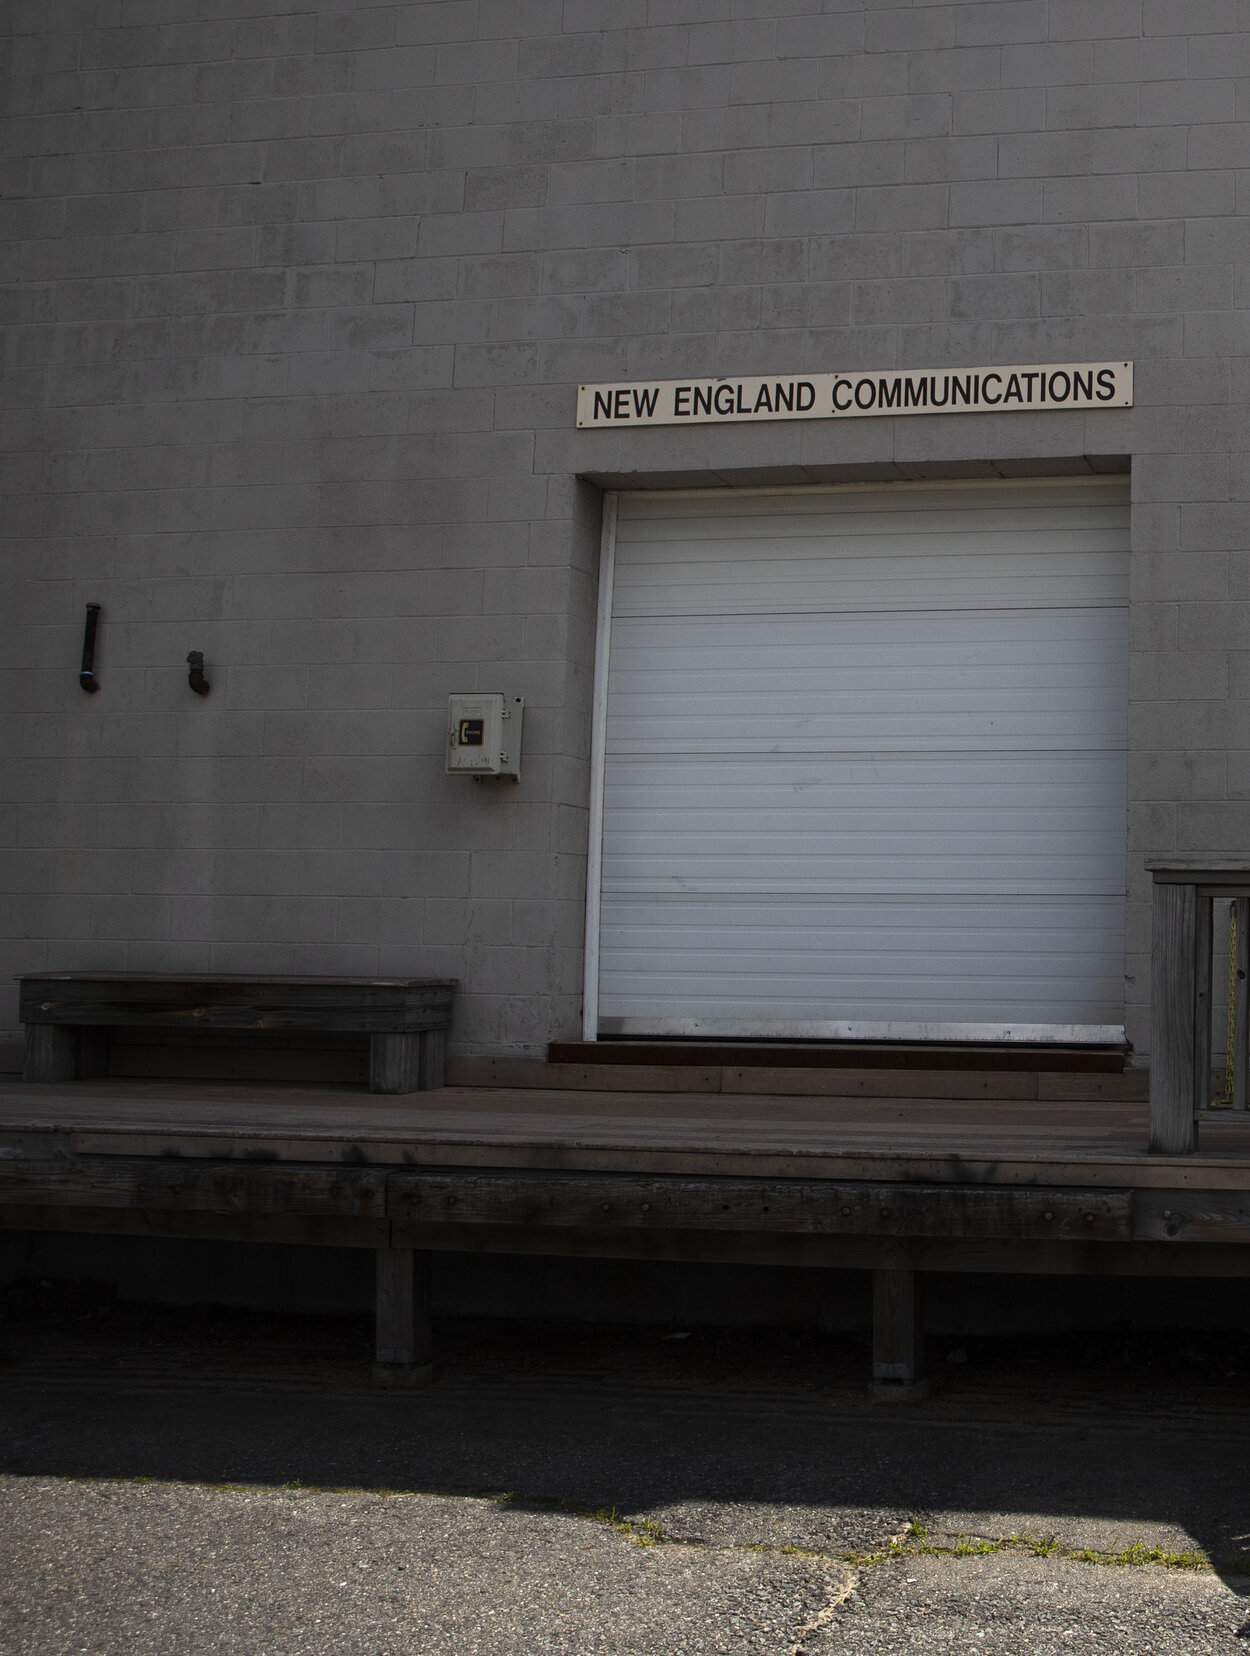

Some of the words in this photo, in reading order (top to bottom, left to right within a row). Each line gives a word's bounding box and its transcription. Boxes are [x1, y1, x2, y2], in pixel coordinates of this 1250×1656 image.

[593, 387, 660, 420] NEW
[674, 381, 816, 416] ENGLAND
[832, 369, 1116, 411] COMMUNICATIONS
